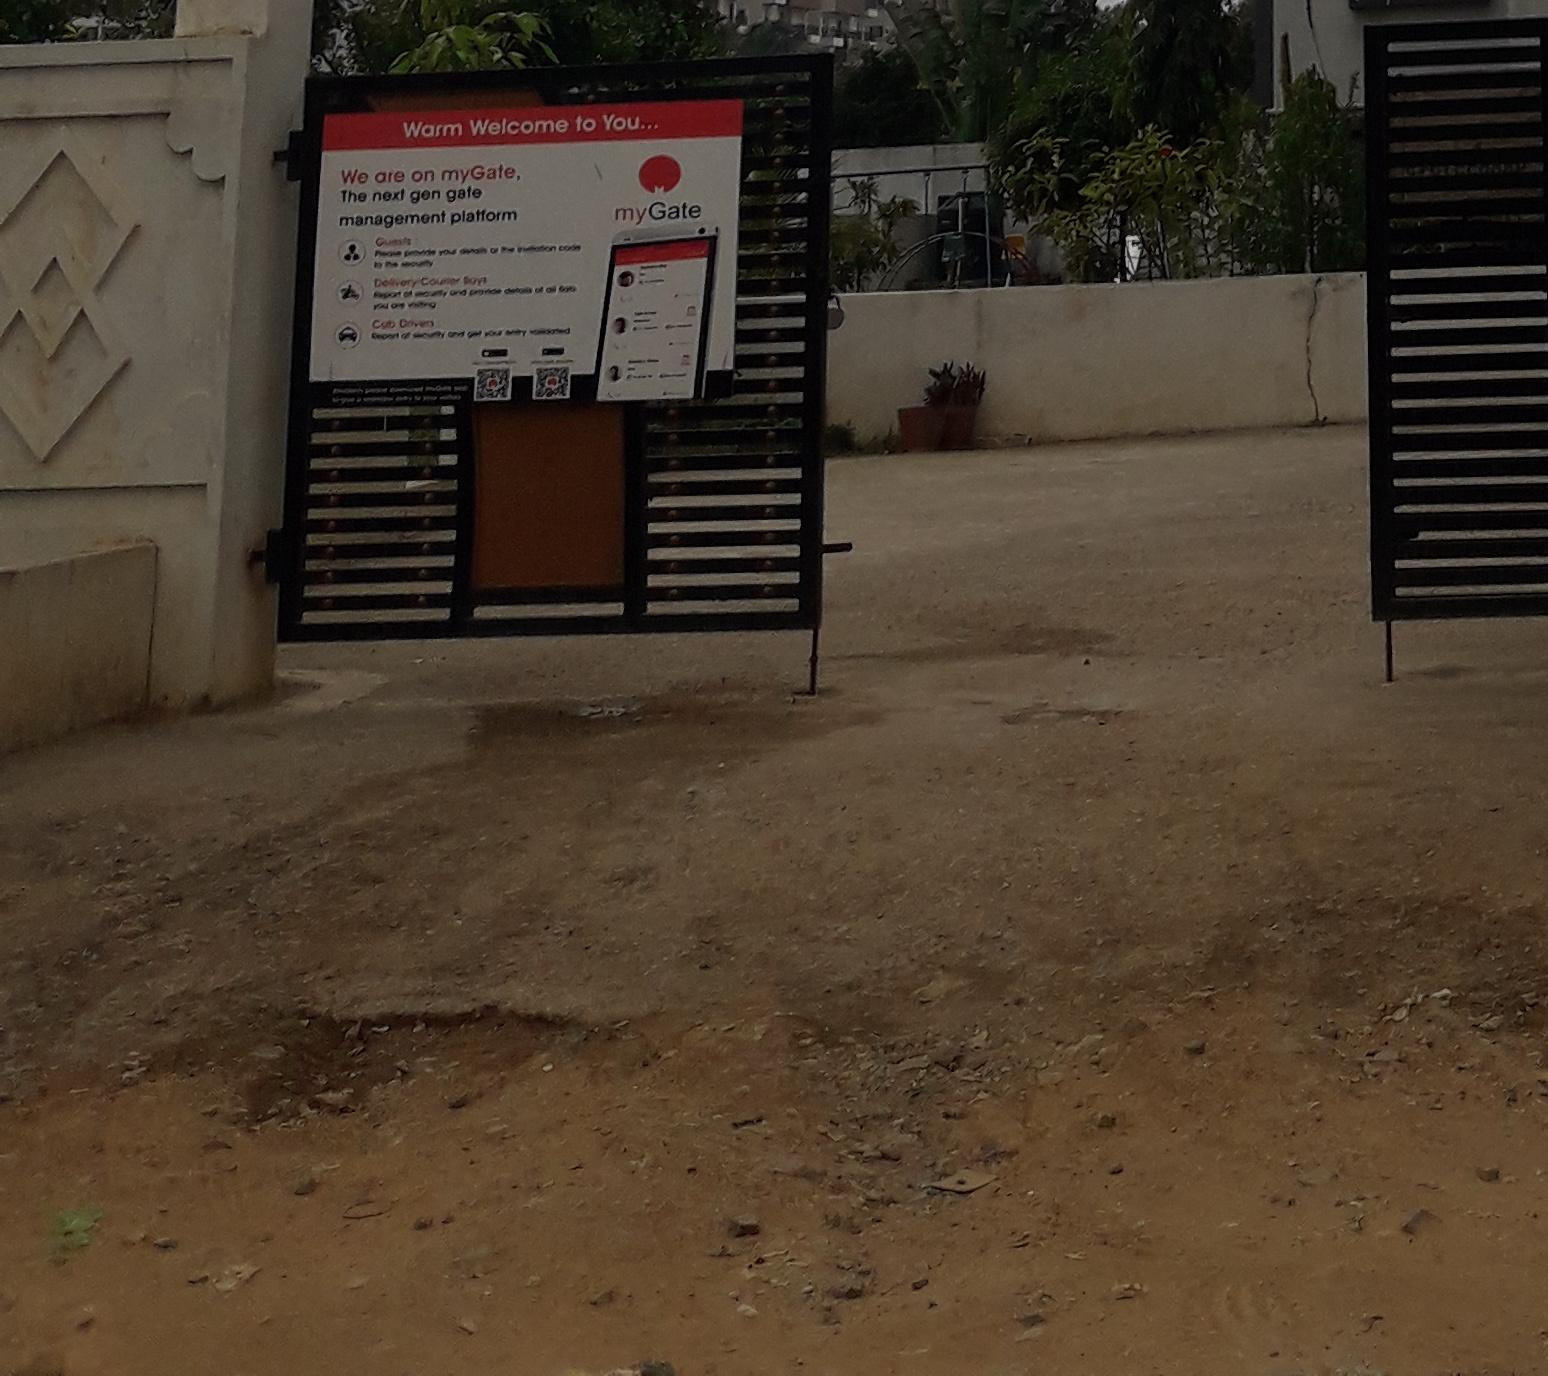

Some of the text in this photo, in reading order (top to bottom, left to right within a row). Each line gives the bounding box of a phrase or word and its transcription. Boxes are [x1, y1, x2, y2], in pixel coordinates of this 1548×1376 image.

[403, 114, 659, 138] Warm Welcome to You...
[341, 164, 521, 184] We are on myGate,
[340, 186, 482, 203] The next gen gate
[339, 208, 518, 228] management platform
[614, 200, 702, 225] myGate
[371, 319, 396, 329] Cab
